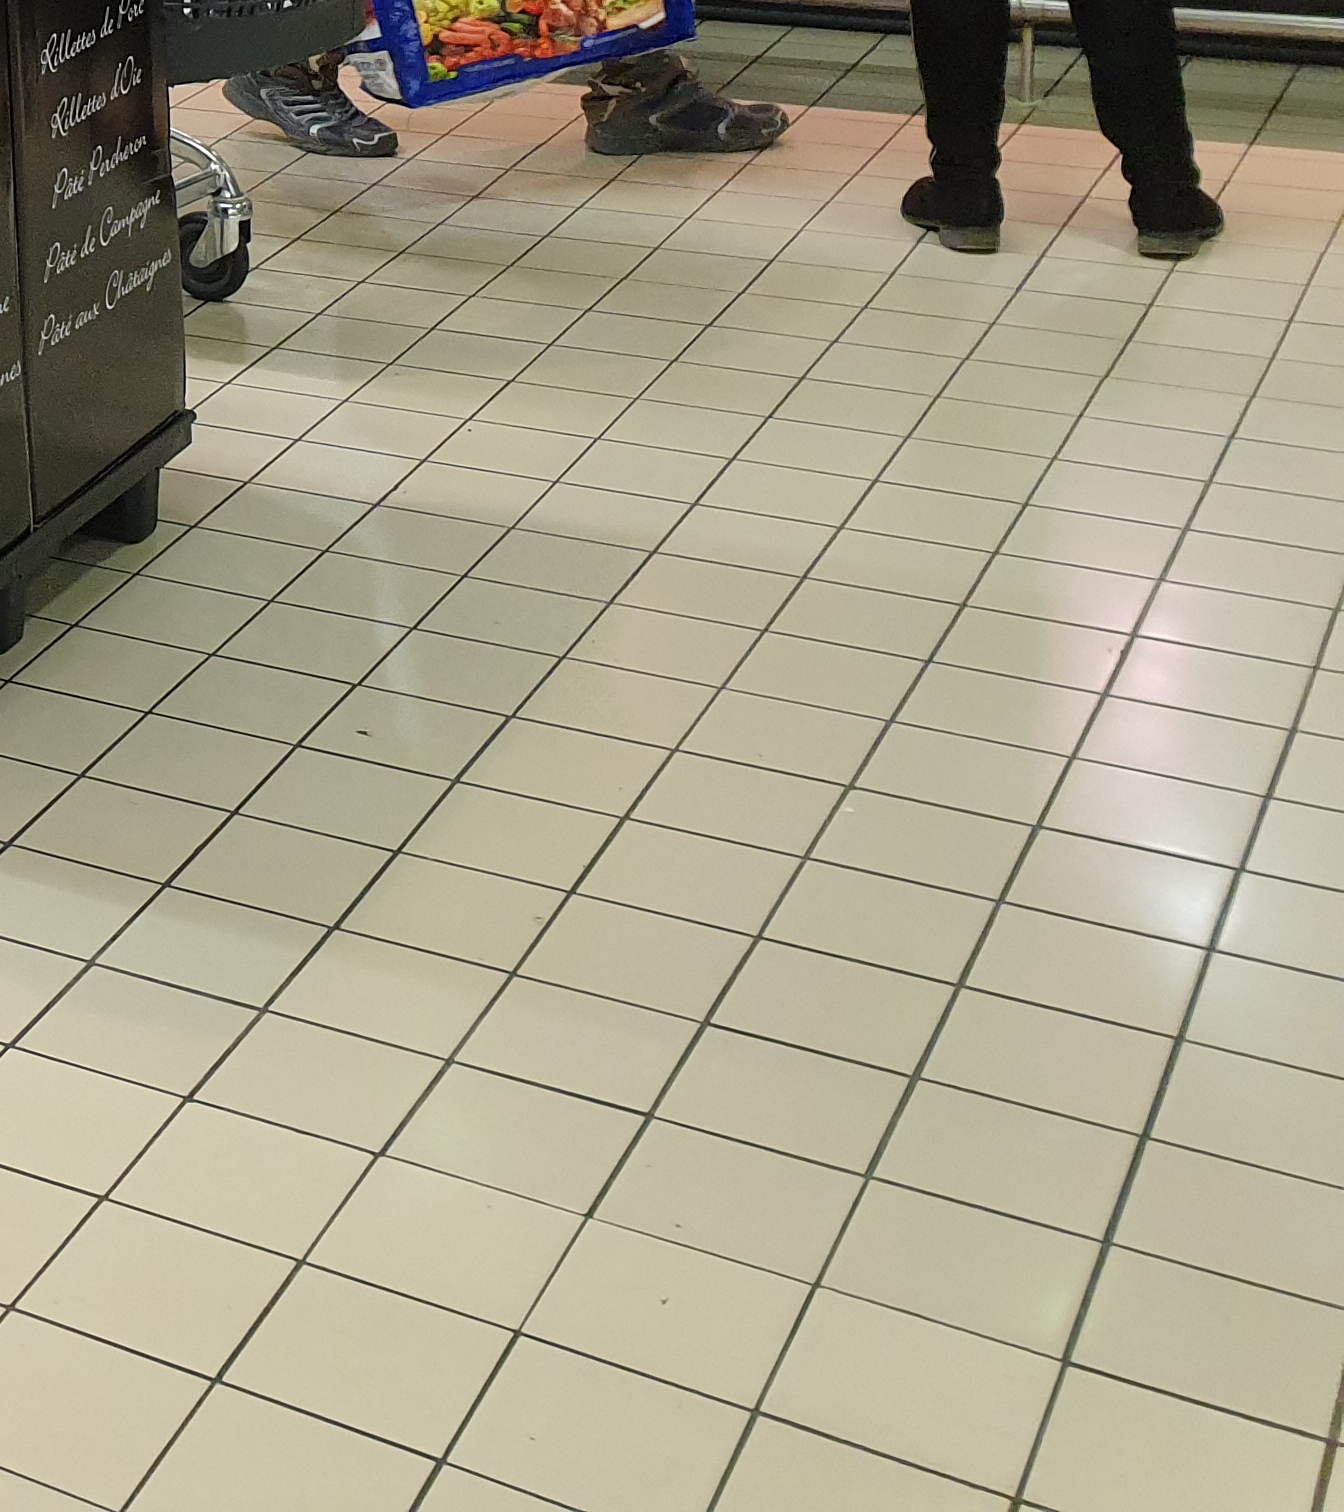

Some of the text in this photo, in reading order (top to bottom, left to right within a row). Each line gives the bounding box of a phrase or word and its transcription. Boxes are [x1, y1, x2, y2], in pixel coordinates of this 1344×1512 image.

[41, 29, 96, 75] Rillettes
[100, 6, 114, 38] de
[51, 55, 143, 139] Rillettes d'Oie
[38, 248, 172, 356] Pâté aux Châtaignes
